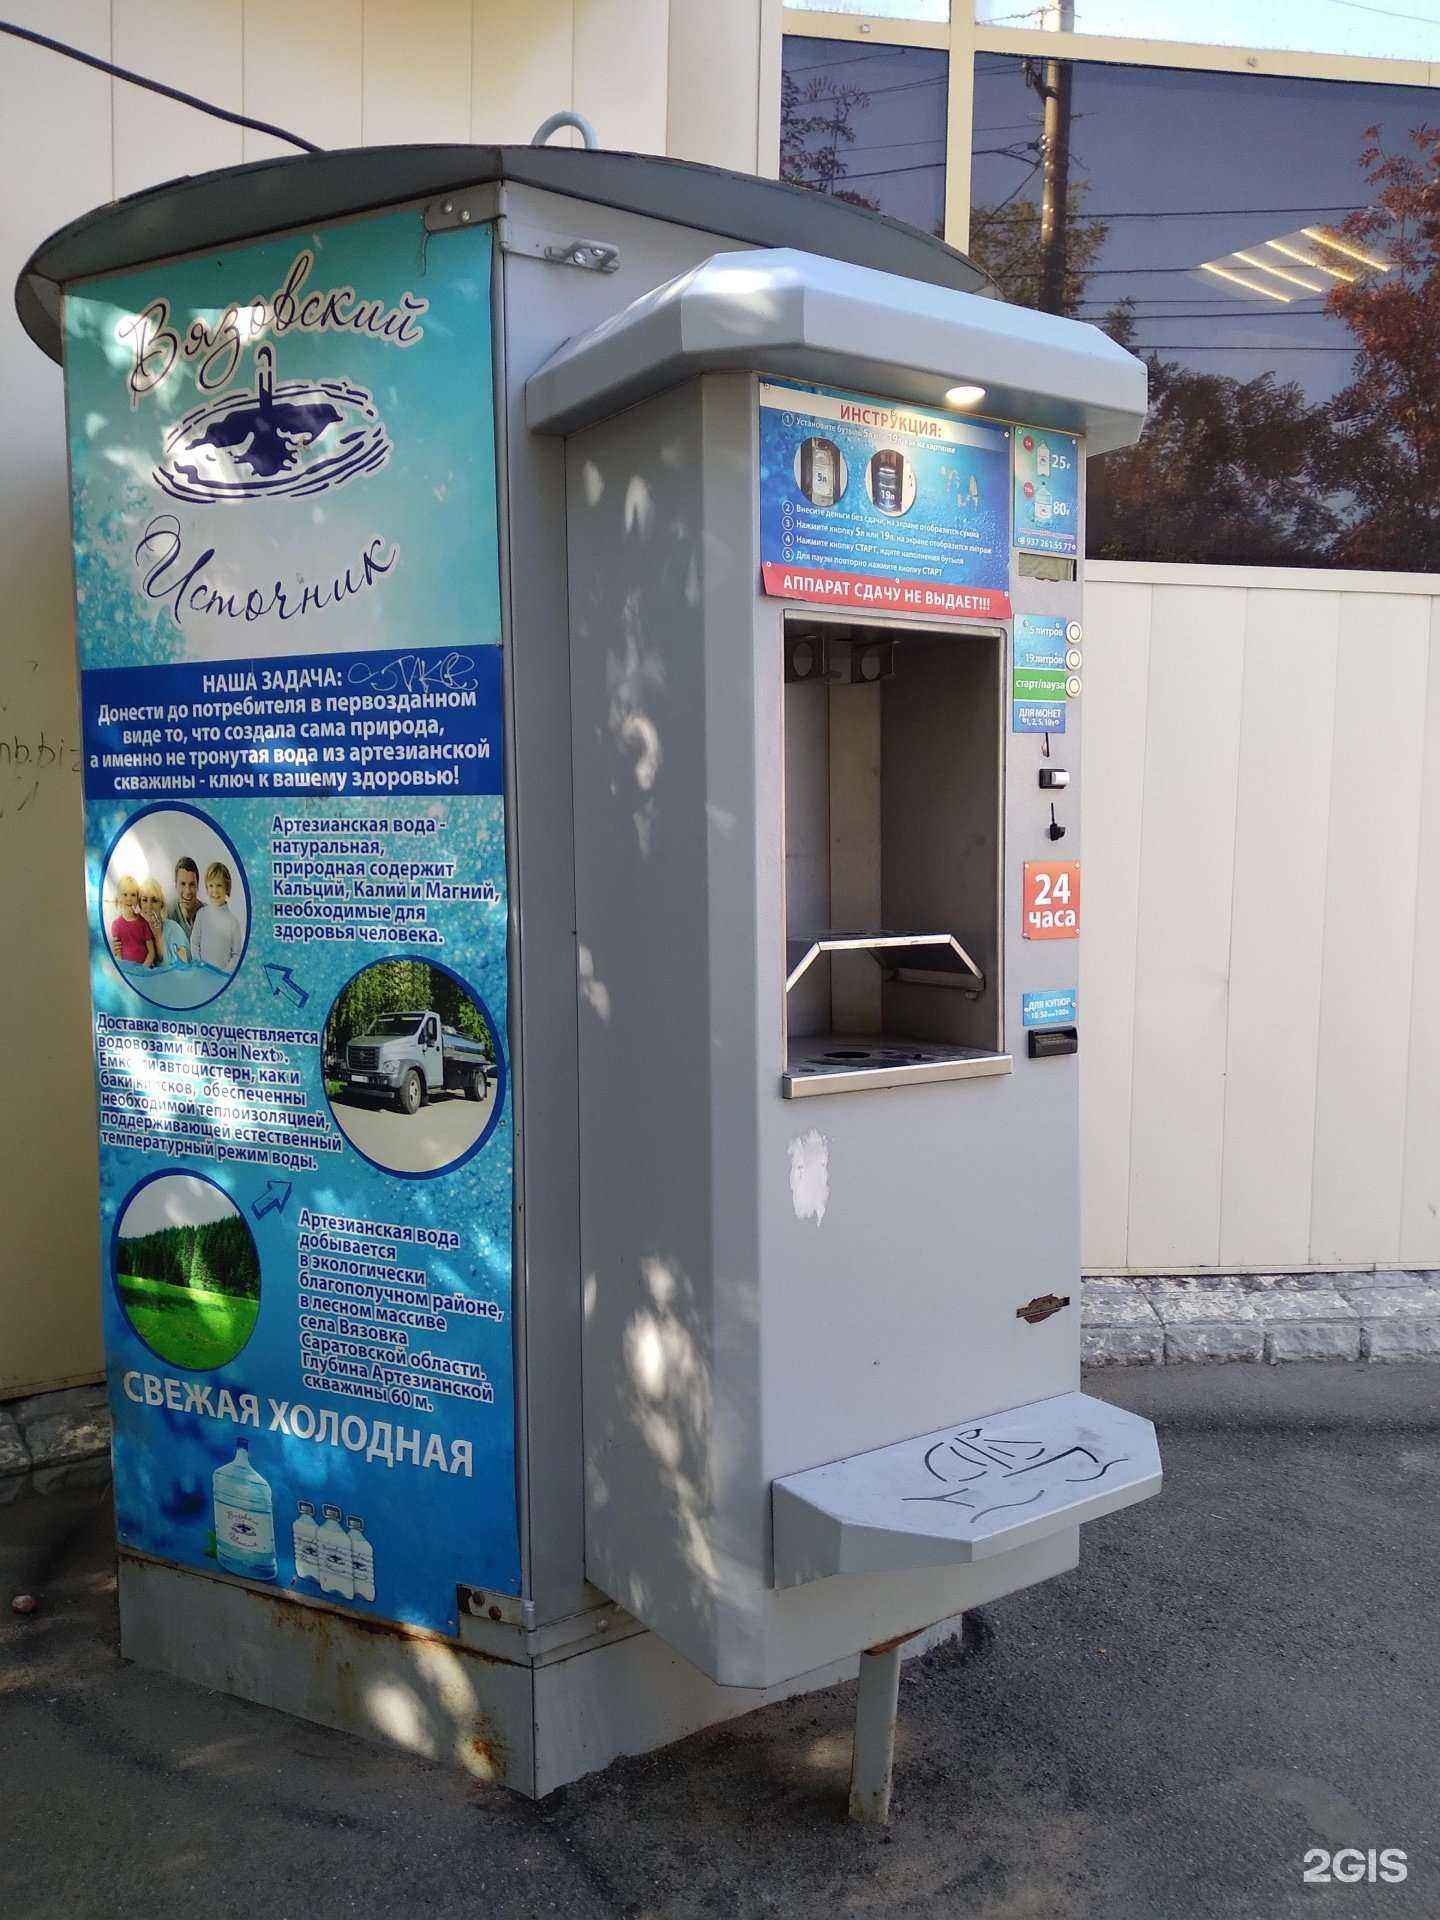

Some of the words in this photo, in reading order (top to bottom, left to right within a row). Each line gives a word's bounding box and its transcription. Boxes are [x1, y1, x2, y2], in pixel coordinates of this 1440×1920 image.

[119, 253, 425, 408] Вязовский
[840, 404, 942, 438] ИНСТРУКЦИЯ:
[816, 472, 827, 483] 5л
[880, 489, 895, 501] 19л
[136, 514, 396, 625] Источник
[783, 575, 849, 596] АППАРАТ
[854, 582, 901, 602] СДАЧУ
[905, 589, 922, 604] НЕ
[926, 590, 991, 611] ВЫДАЕТ!!!
[203, 670, 258, 694] НАША
[262, 667, 343, 693] ЗАДАЧА:
[1016, 679, 1065, 691] старт/пауза
[98, 702, 164, 726] Донести
[168, 705, 188, 723] до
[193, 698, 306, 723] потребителя
[311, 699, 321, 713] в
[326, 691, 477, 714] первозданном
[1019, 708, 1034, 718] ДЛЯ
[1035, 709, 1061, 718] МОНЕТ
[123, 729, 161, 746] виде
[165, 727, 188, 745] то,
[192, 725, 221, 741] что
[224, 723, 296, 743] создала
[300, 721, 346, 738] сама
[351, 717, 444, 740] природа,
[90, 756, 98, 769] а
[102, 753, 163, 768] именно
[166, 752, 186, 766] не
[189, 749, 270, 771] тронутая
[274, 747, 318, 767] вода
[323, 746, 345, 762] из
[350, 738, 490, 765] артезианской
[114, 774, 196, 791] скважины
[209, 774, 254, 789] ключ
[259, 773, 269, 787] к
[273, 771, 347, 792] вашему
[352, 766, 460, 789] здоровью!
[273, 816, 388, 836] Артезианская
[393, 819, 435, 835] вода
[273, 839, 384, 857] натуральная,
[273, 861, 365, 878] природная
[370, 863, 454, 880] содержит
[273, 880, 349, 899] Кальций,
[354, 881, 406, 899] Калий
[411, 885, 421, 898] и
[426, 883, 500, 902] Магний,
[1035, 873, 1070, 905] 24
[274, 901, 391, 921] необходимые
[395, 905, 425, 922] для
[1029, 909, 1075, 928] часа
[275, 924, 355, 943] здоровья
[359, 928, 443, 943] человека.
[98, 1014, 158, 1032] Доставка
[162, 1022, 197, 1037] воды
[201, 1024, 318, 1045] осуществляется
[99, 1036, 183, 1055] водовозами
[159, 1057, 255, 1083] автоцистерн,
[259, 1067, 285, 1082] как
[290, 1071, 299, 1084] и
[101, 1071, 132, 1088] баки
[203, 1083, 305, 1106] обеспеченны
[102, 1091, 195, 1115] необходимой
[200, 1102, 329, 1131] теплоизоляцией,
[102, 1111, 231, 1140] поддерживающей
[235, 1126, 341, 1151] естественный
[102, 1131, 214, 1157] температурный
[218, 1144, 268, 1162] режим
[272, 1151, 317, 1170] воды.
[301, 1210, 412, 1240] Артезианская
[417, 1231, 459, 1247] вода
[300, 1233, 396, 1259] добывается
[300, 1255, 308, 1266] в
[313, 1256, 425, 1285] экологически
[300, 1272, 428, 1306] благополучном
[433, 1293, 503, 1320] районе,
[300, 1295, 309, 1308] в
[313, 1298, 372, 1317] лесном
[376, 1308, 446, 1330] массиве
[301, 1315, 335, 1332] села
[340, 1318, 407, 1345] Вязовка
[302, 1333, 406, 1364] Саратовской
[411, 1352, 486, 1379] области.
[303, 1352, 368, 1378] Глубина
[373, 1366, 492, 1401] Артезианской
[305, 1374, 387, 1400] скважины
[391, 1389, 410, 1405] 60
[415, 1396, 432, 1410] м.
[123, 1371, 260, 1428] СВЕЖАЯ
[268, 1398, 473, 1477] ХОЛОДНАЯ
